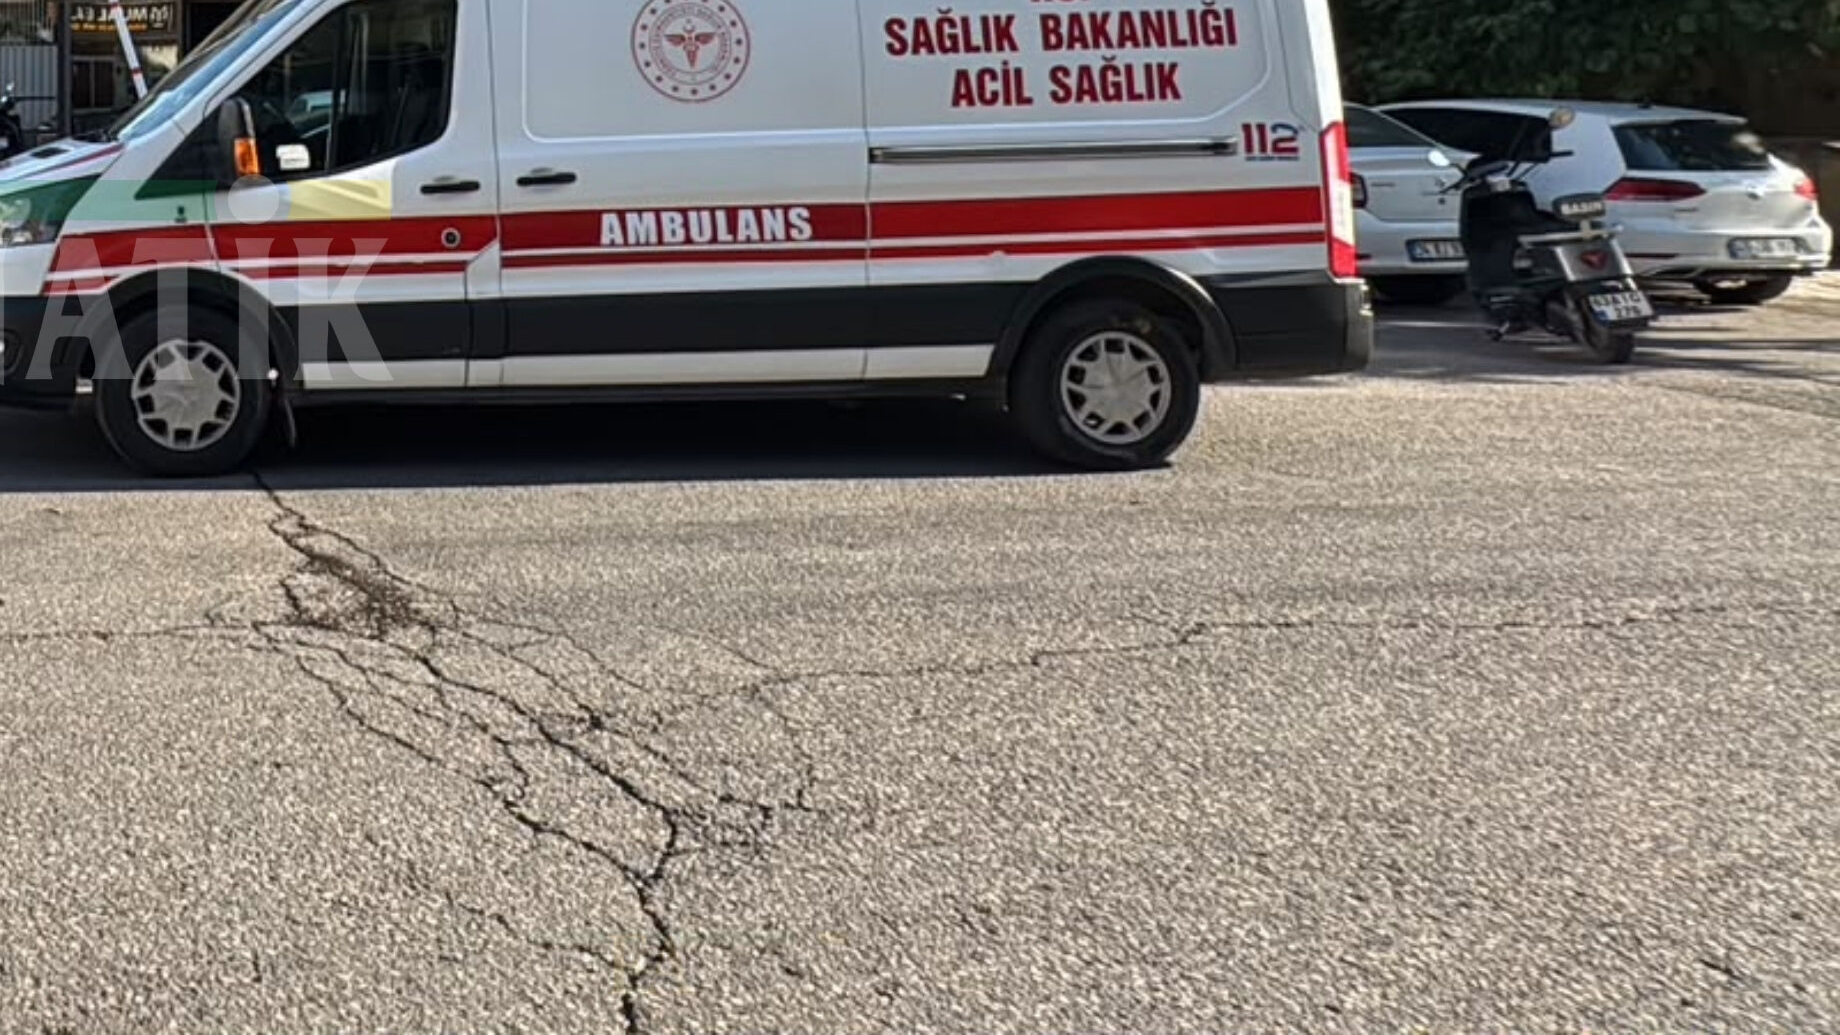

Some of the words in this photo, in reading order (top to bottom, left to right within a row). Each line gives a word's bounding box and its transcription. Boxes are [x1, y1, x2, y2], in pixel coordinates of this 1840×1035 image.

[884, 7, 1019, 56] SAĞLIK
[1039, 0, 1238, 52] BAKANLIĞI
[950, 59, 1034, 108] ACİL
[1048, 55, 1183, 104] SAĞLIK
[1241, 122, 1299, 154] 112
[599, 206, 814, 246] AMBULANS
